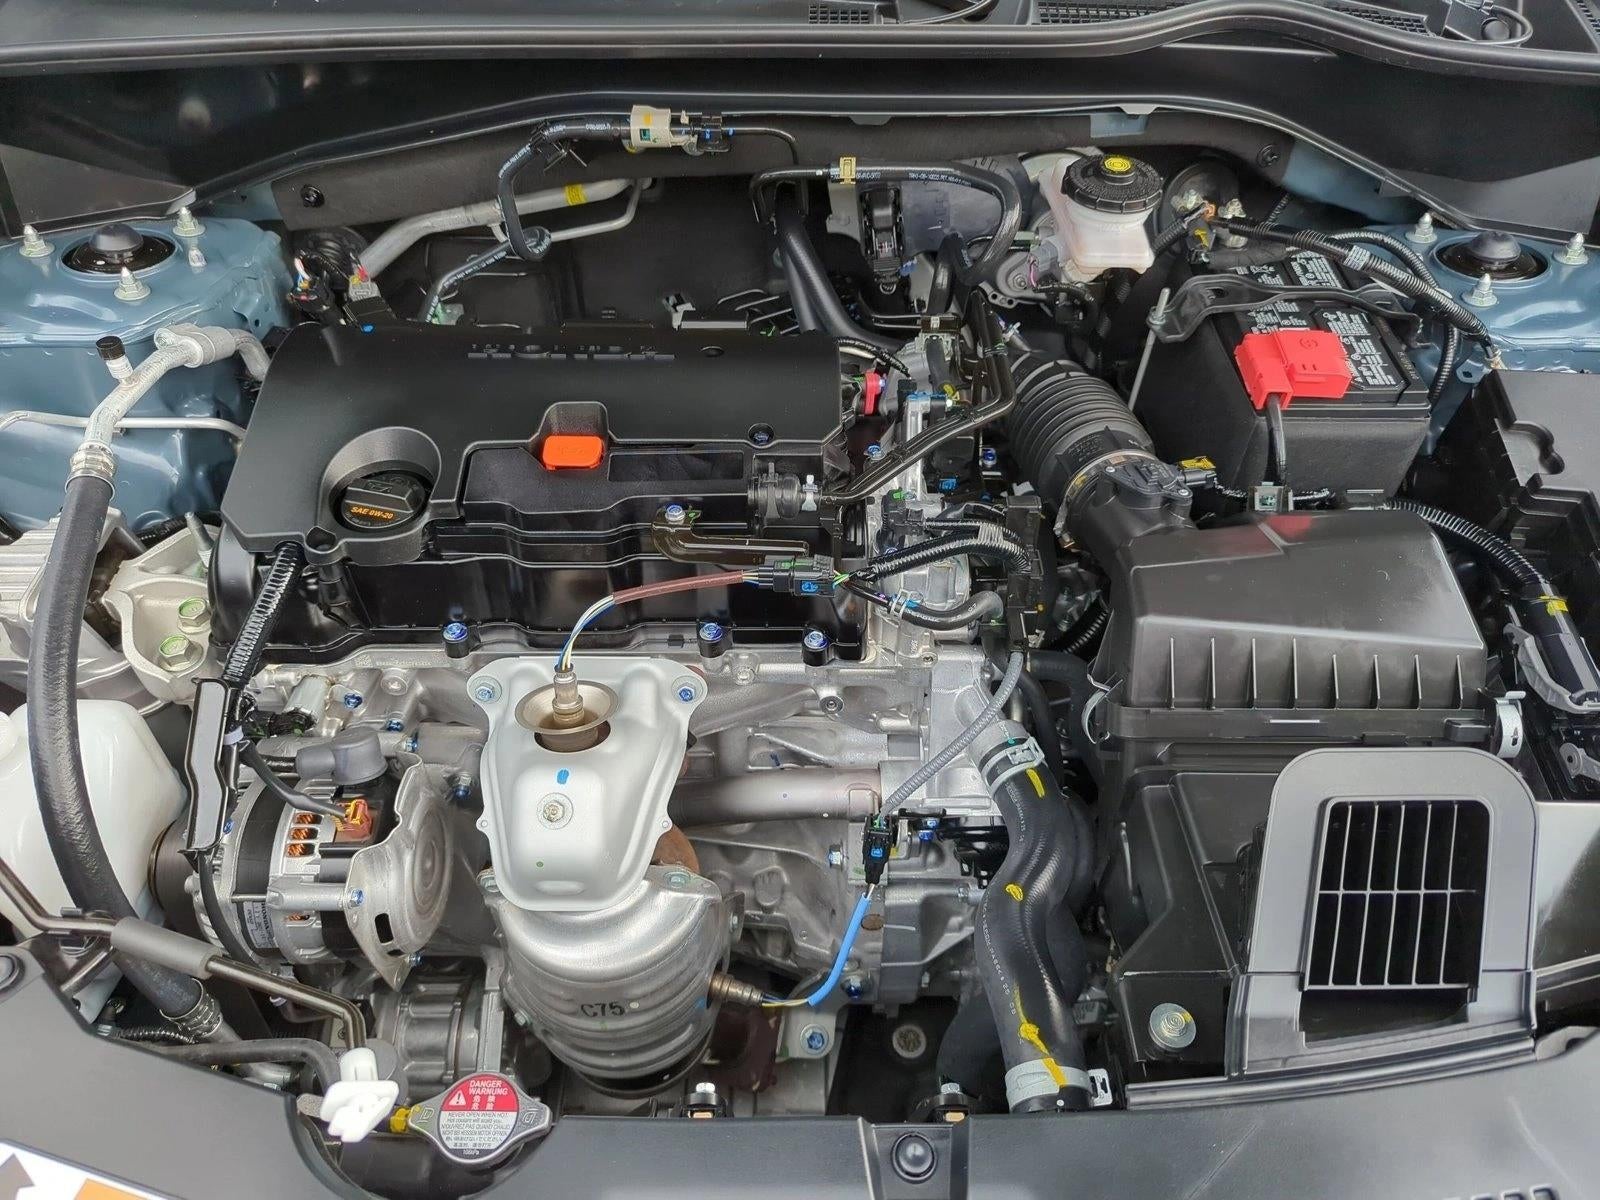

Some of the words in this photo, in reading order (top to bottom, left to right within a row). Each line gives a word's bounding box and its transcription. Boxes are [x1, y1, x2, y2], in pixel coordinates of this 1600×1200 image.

[350, 506, 368, 515] SAE
[369, 509, 394, 519] 0W-20
[580, 1001, 625, 1017] C75
[468, 1087, 508, 1096] WARNUNG
